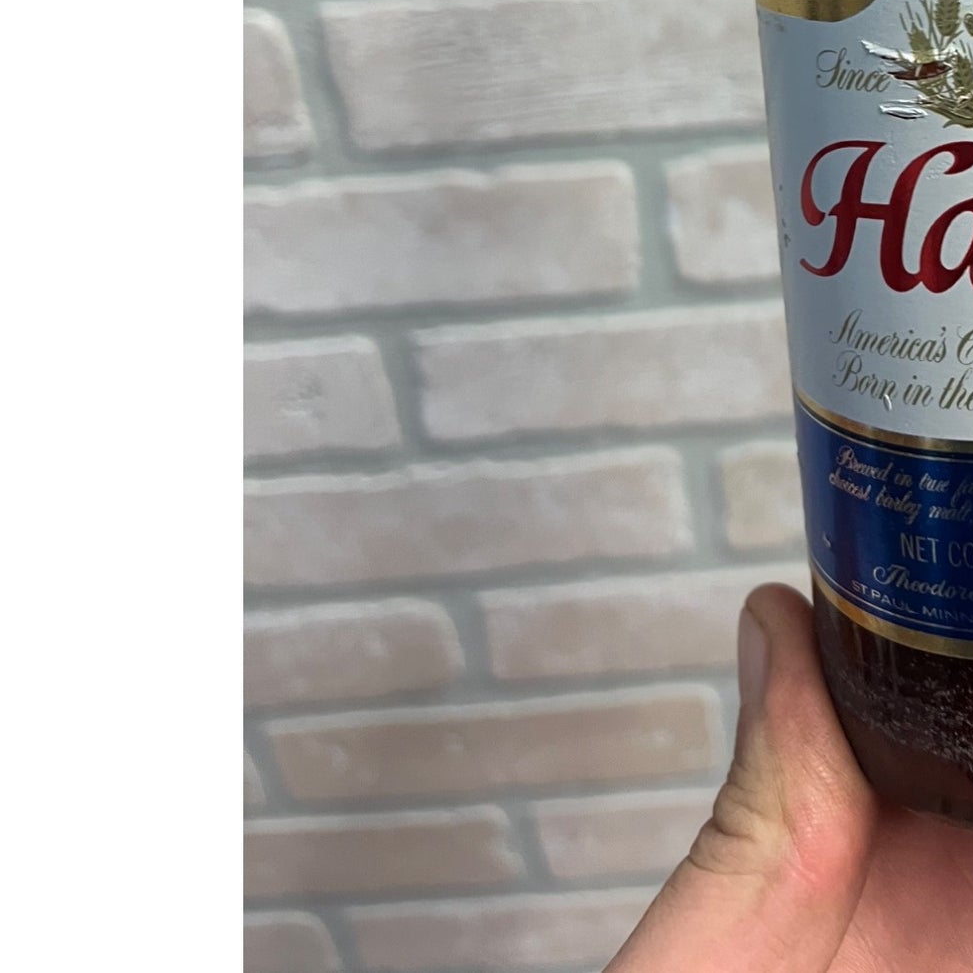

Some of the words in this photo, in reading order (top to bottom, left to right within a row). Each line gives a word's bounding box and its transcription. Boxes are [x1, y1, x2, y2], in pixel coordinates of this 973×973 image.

[815, 49, 890, 94] Since
[829, 308, 947, 364] America's
[832, 352, 898, 412] Born
[903, 376, 935, 408] in
[836, 446, 894, 482] Brewed
[894, 469, 914, 488] in
[918, 473, 951, 493] true
[874, 486, 923, 525] barley
[900, 533, 940, 564] NET
